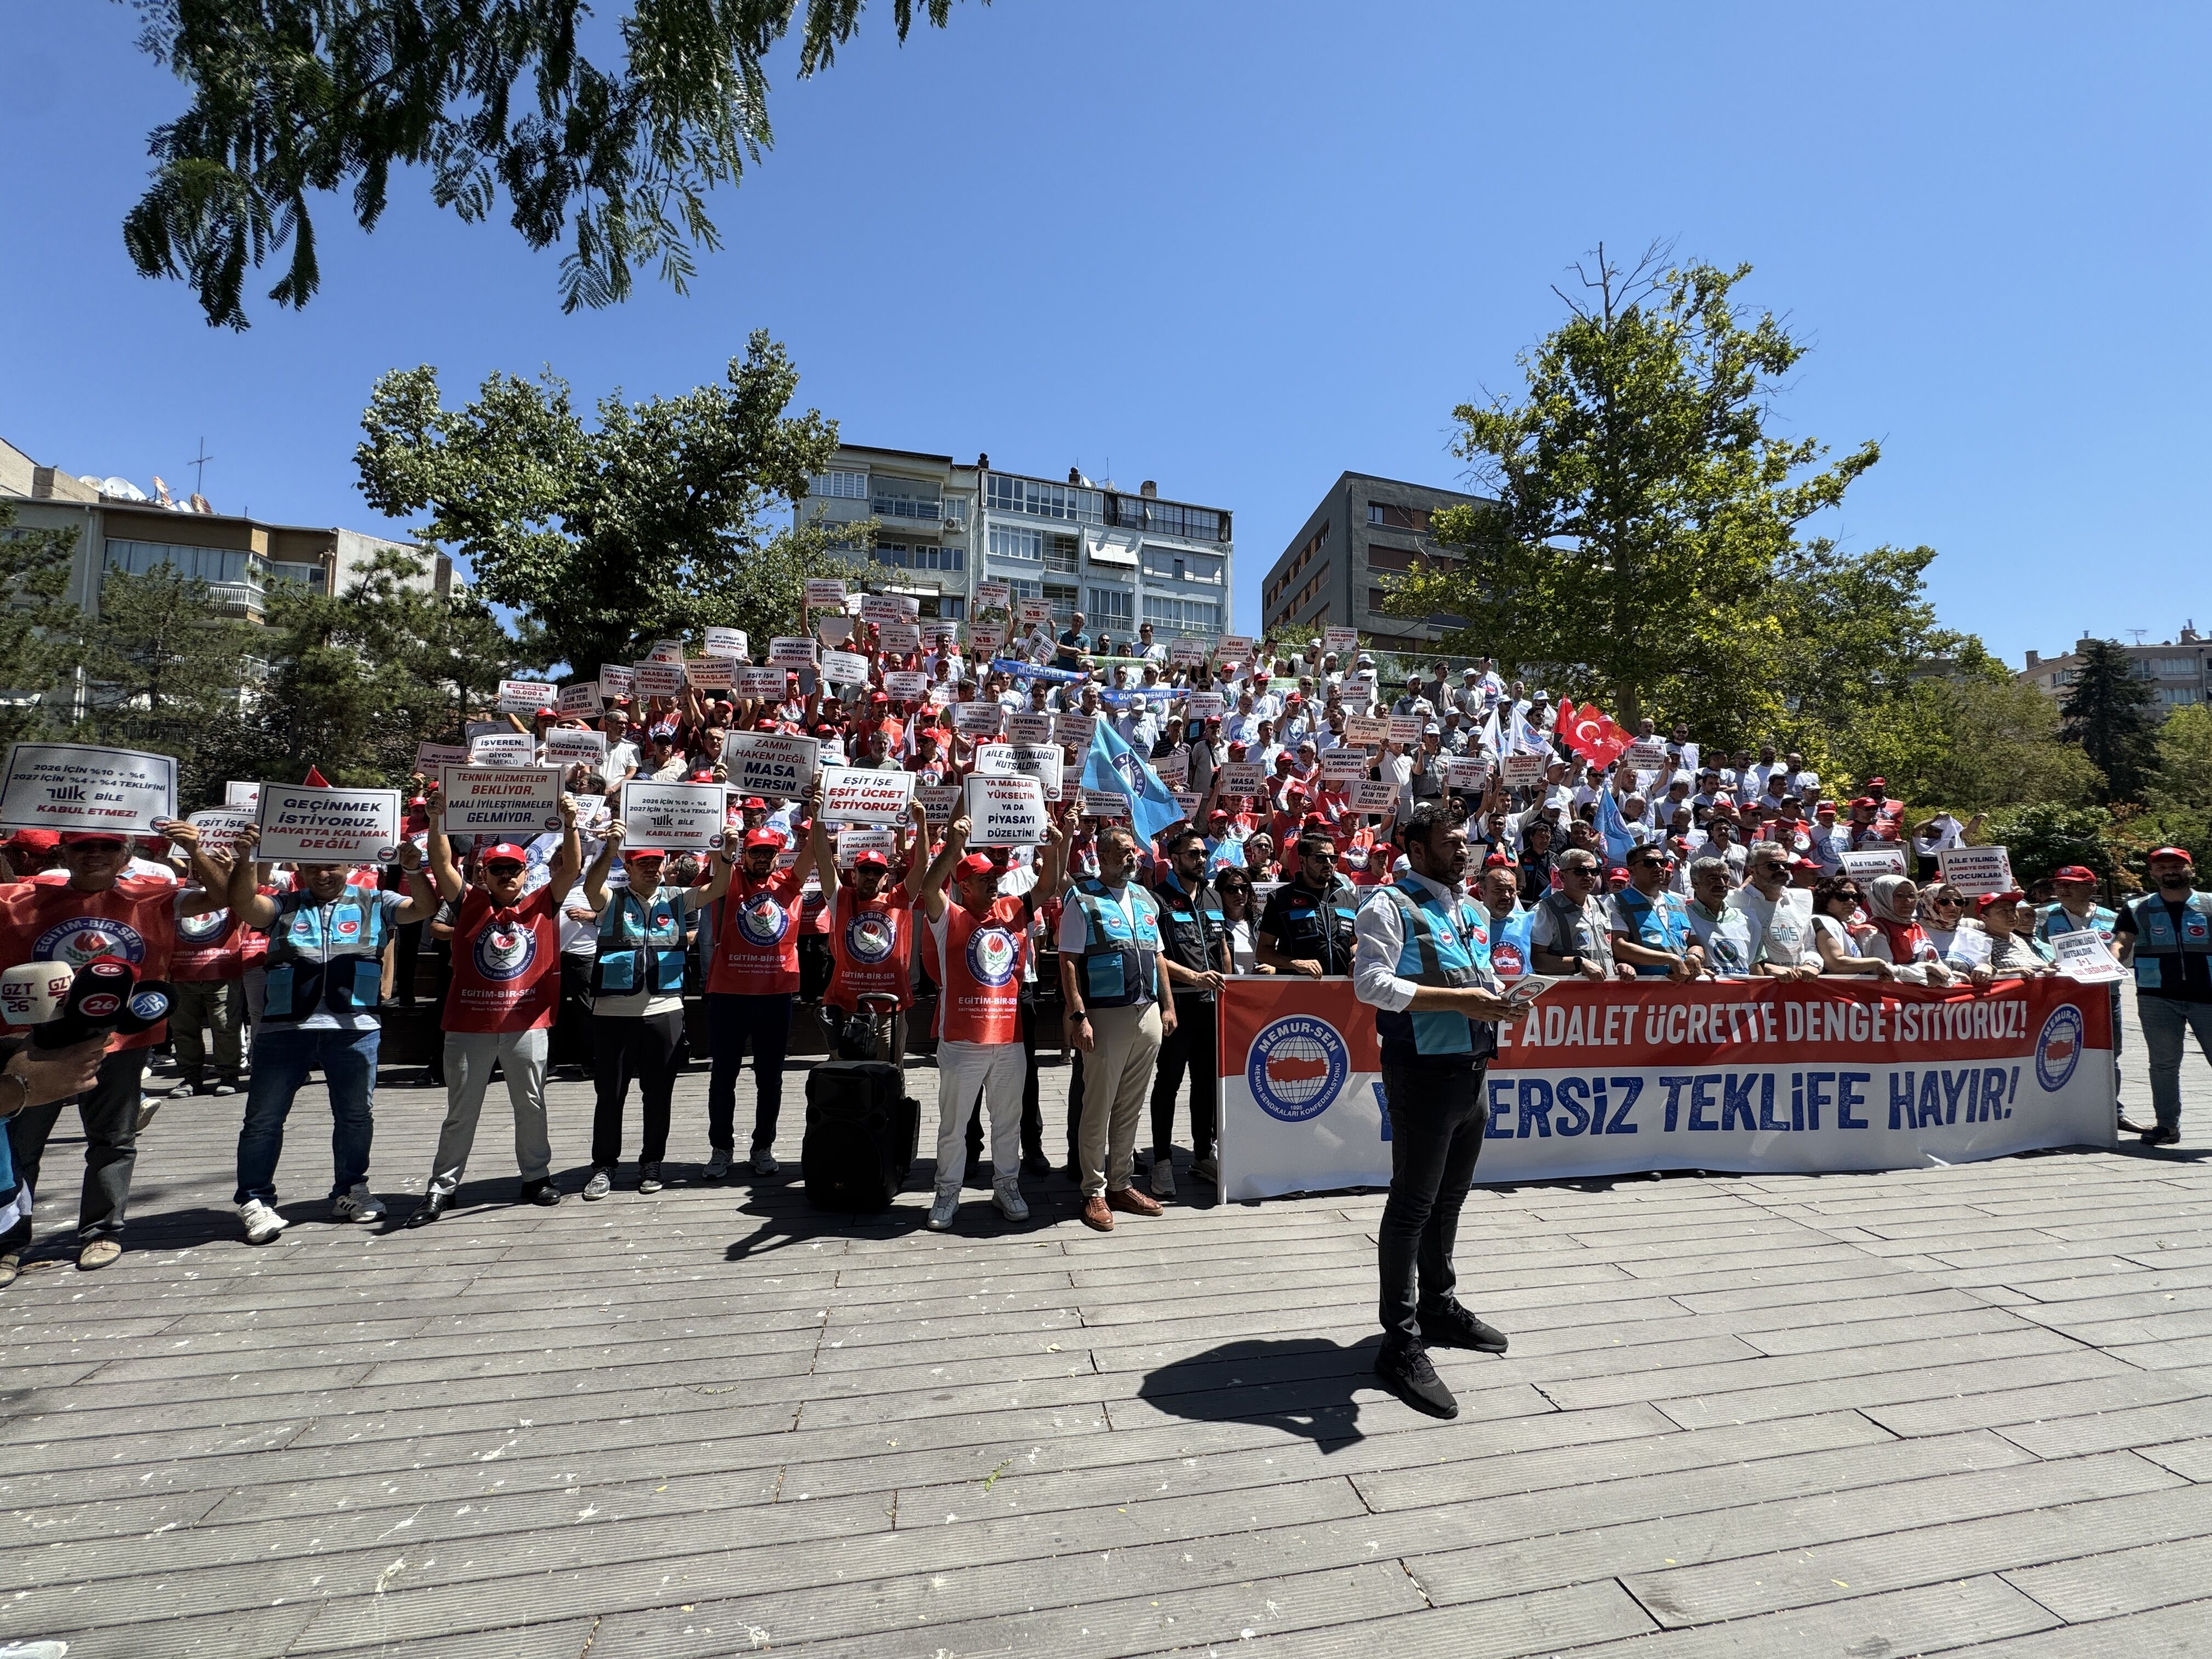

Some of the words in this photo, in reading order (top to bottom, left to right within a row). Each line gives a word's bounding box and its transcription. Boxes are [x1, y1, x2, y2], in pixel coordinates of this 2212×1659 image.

[1018, 665, 1066, 679] MÜCADELE
[1145, 691, 1171, 699] MEMUR
[562, 702, 592, 710] ÜZERİNDEN
[755, 739, 792, 751] ZAMMI
[735, 749, 775, 761] HAKEM
[777, 753, 807, 764] DEĞİL
[1006, 751, 1054, 760] BÜTÜNLÜĞÜ
[63, 765, 87, 774] İÇİN
[744, 761, 795, 778] MASA
[996, 760, 1042, 770] KUTSALDIR,
[40, 774, 65, 782] İÇİN
[457, 772, 493, 781] TEKNİK
[495, 772, 548, 783] HİZMETLER
[1454, 770, 1480, 778] ADALET?
[743, 776, 797, 792] VERSİN
[843, 776, 871, 785] EŞİT
[873, 776, 893, 786] İŞE
[471, 783, 534, 796] BEKLİYOR,
[828, 787, 859, 797] EŞİT
[861, 787, 905, 798] ÜCRET
[94, 793, 125, 802] BİLE
[988, 791, 1035, 799] YÜKSELTİN
[284, 799, 382, 812] GEÇİNMEK
[449, 799, 473, 808] MALİ
[477, 799, 553, 809] İYİLEŞTİRMELER
[829, 800, 901, 812] İSTİYORUZ!
[36, 804, 84, 814] KABUL
[87, 808, 138, 817] ETMEZ!
[278, 811, 379, 828] İSTİYORUZ,
[467, 812, 535, 823] GELMİYOR.
[989, 814, 1035, 824] PİYASAYI
[197, 819, 224, 827] EŞİT
[268, 826, 329, 836] HAYATTA
[988, 828, 1034, 837] DÜZELTİN!
[299, 839, 360, 849] DEĞİL!
[1951, 872, 2002, 881] ÇOCUKLARA
[35, 919, 141, 953] EĞİTİM-BİR-SEN
[842, 970, 895, 979] EĞİTİM-BİR-SEN
[2, 983, 34, 995] GZT
[462, 988, 535, 998] EĞİTİM-BİR-SEN
[88, 1000, 115, 1011] 26
[958, 996, 1017, 1005] EĞİTİM-BİR-SEN
[8, 1001, 30, 1013] 26
[1522, 1005, 1639, 1047] ADALET
[1646, 1001, 1777, 1044] ÜCRETTE
[1785, 1001, 1886, 1042] DENGE
[1893, 1001, 2027, 1042] İSTİYORUZ!
[1255, 1064, 1263, 1093] MEMUR
[1260, 1092, 1299, 1117] SENDİKALARI
[1300, 1062, 1341, 1116] KONFEDERASYONU
[1660, 1071, 1871, 1132] TEKLİFE
[1888, 1066, 2020, 1130] HAYIR!
